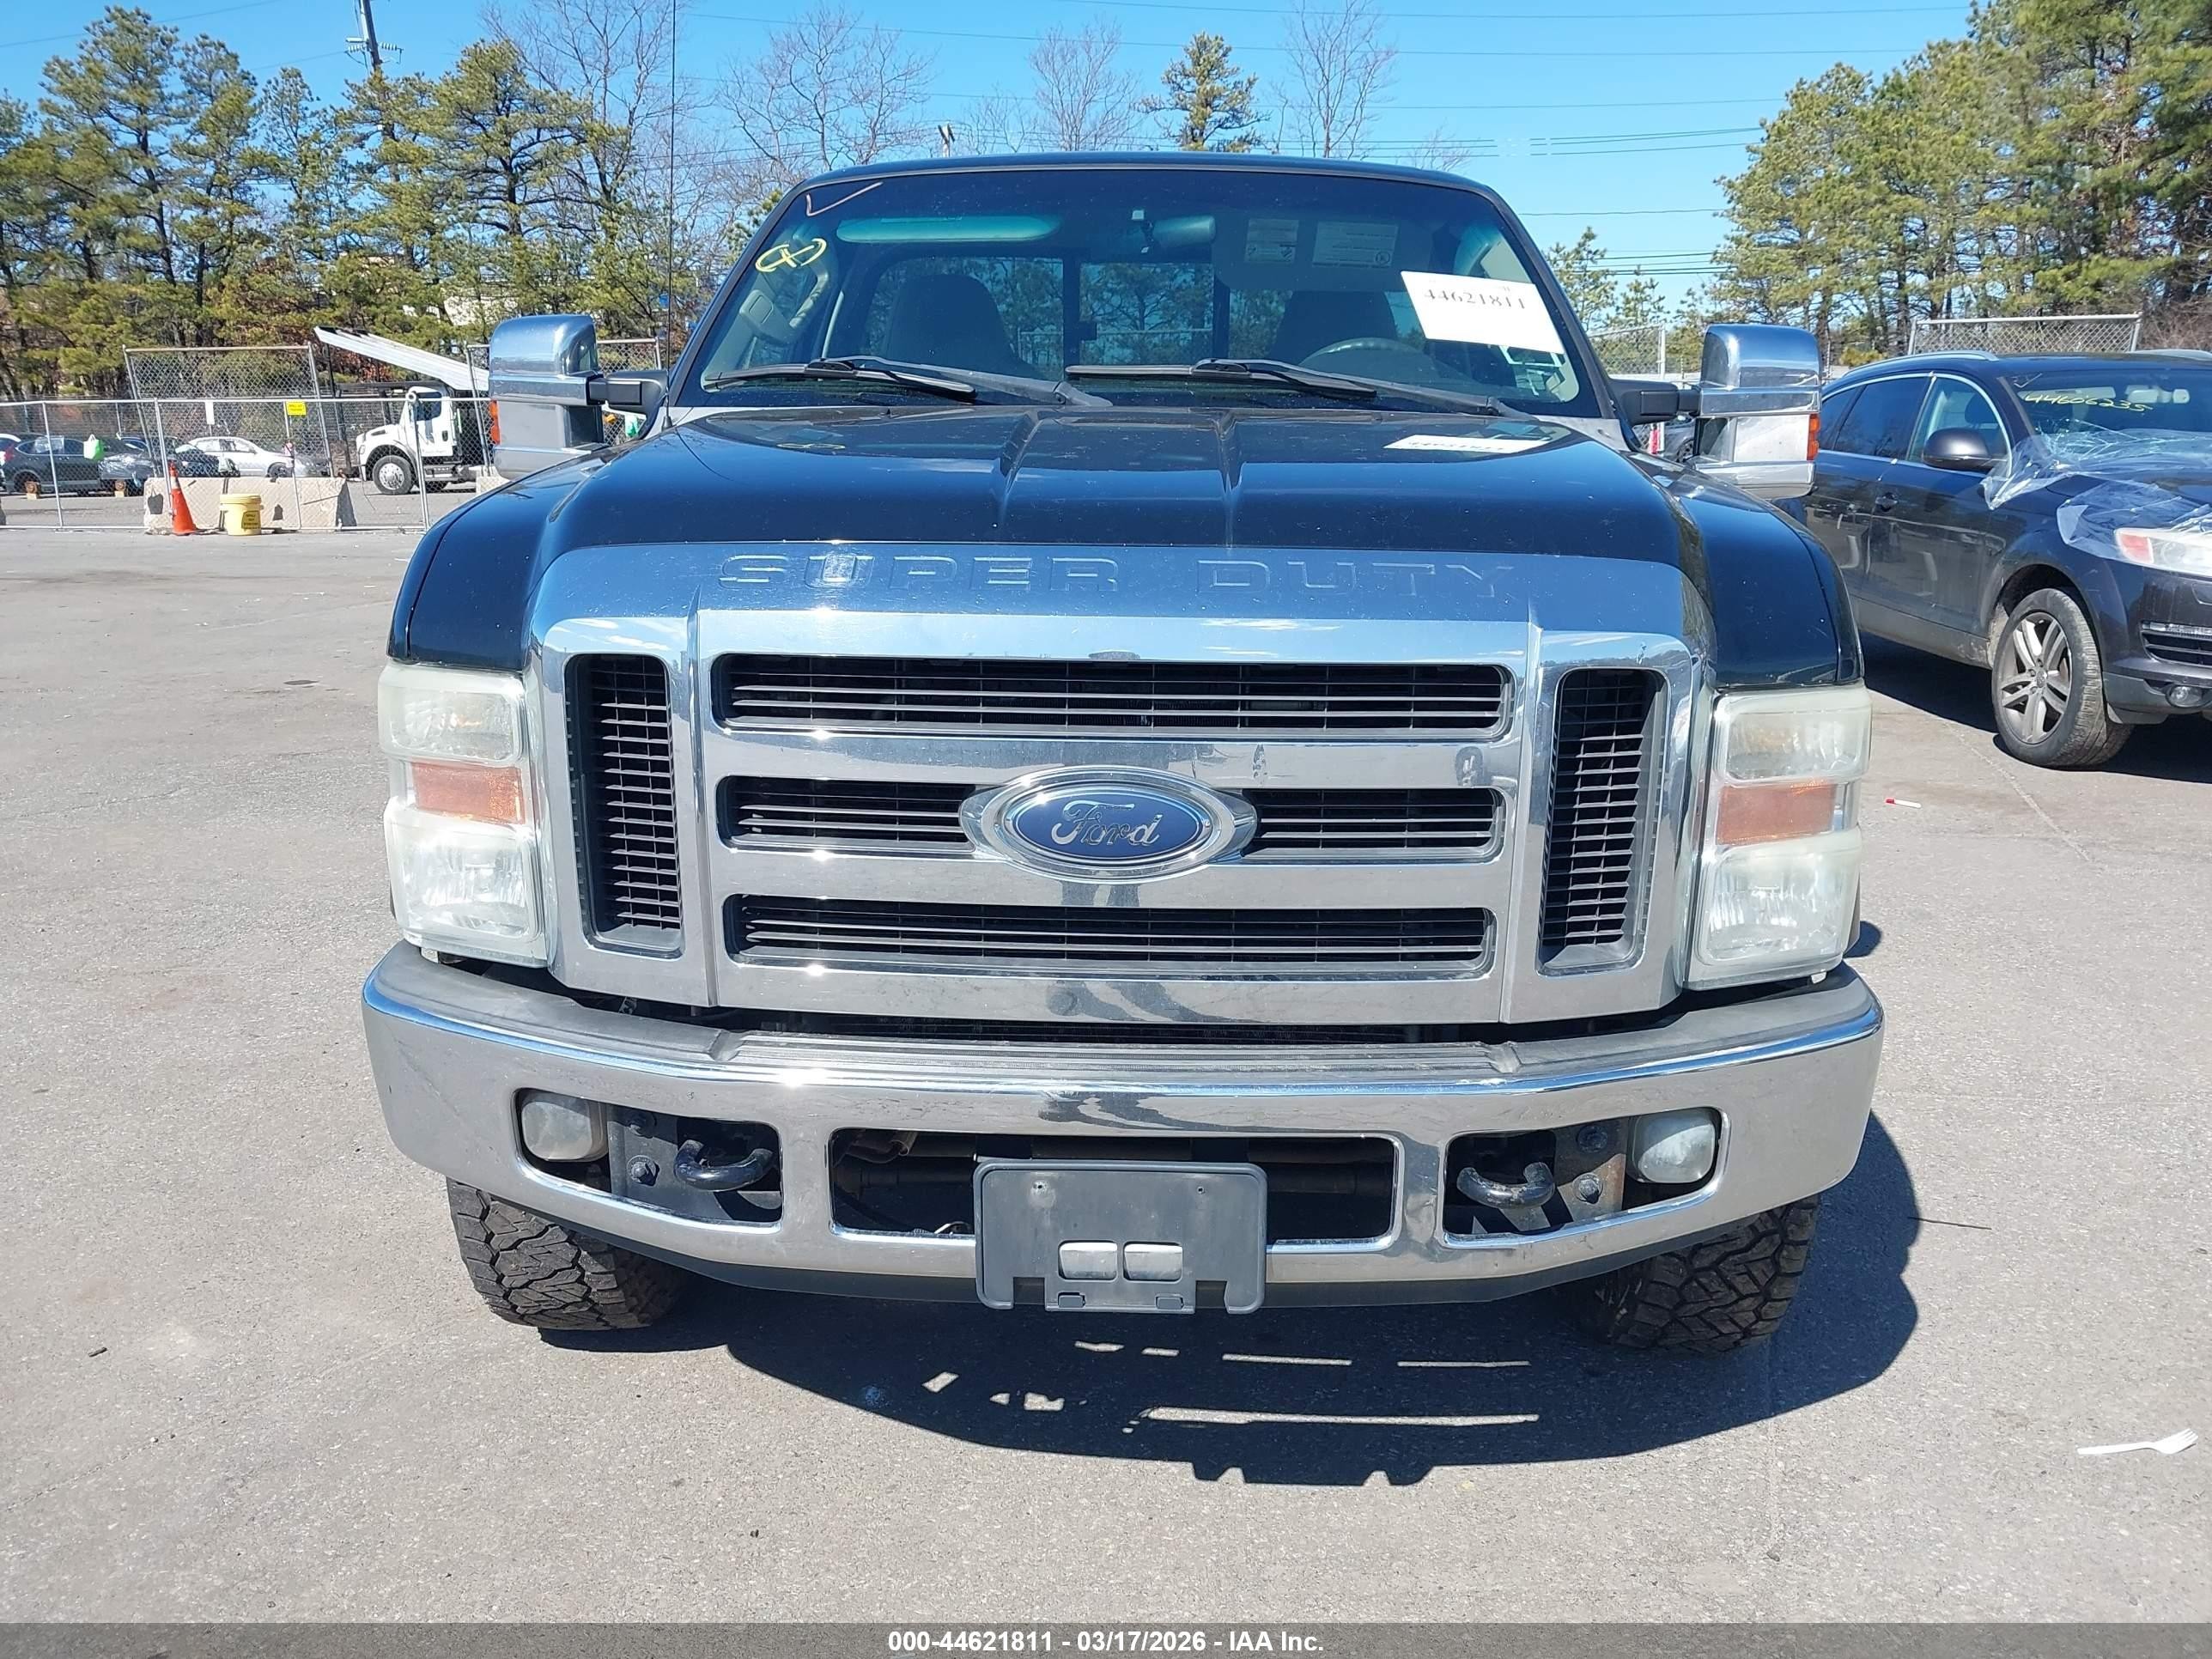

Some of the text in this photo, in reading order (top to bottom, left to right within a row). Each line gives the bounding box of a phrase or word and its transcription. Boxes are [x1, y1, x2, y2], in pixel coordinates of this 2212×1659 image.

[1425, 289, 1526, 309] 44621811
[2025, 394, 2154, 412] 44606235
[718, 555, 1515, 599] SUPER DUTY
[1051, 799, 1164, 846] Ford
